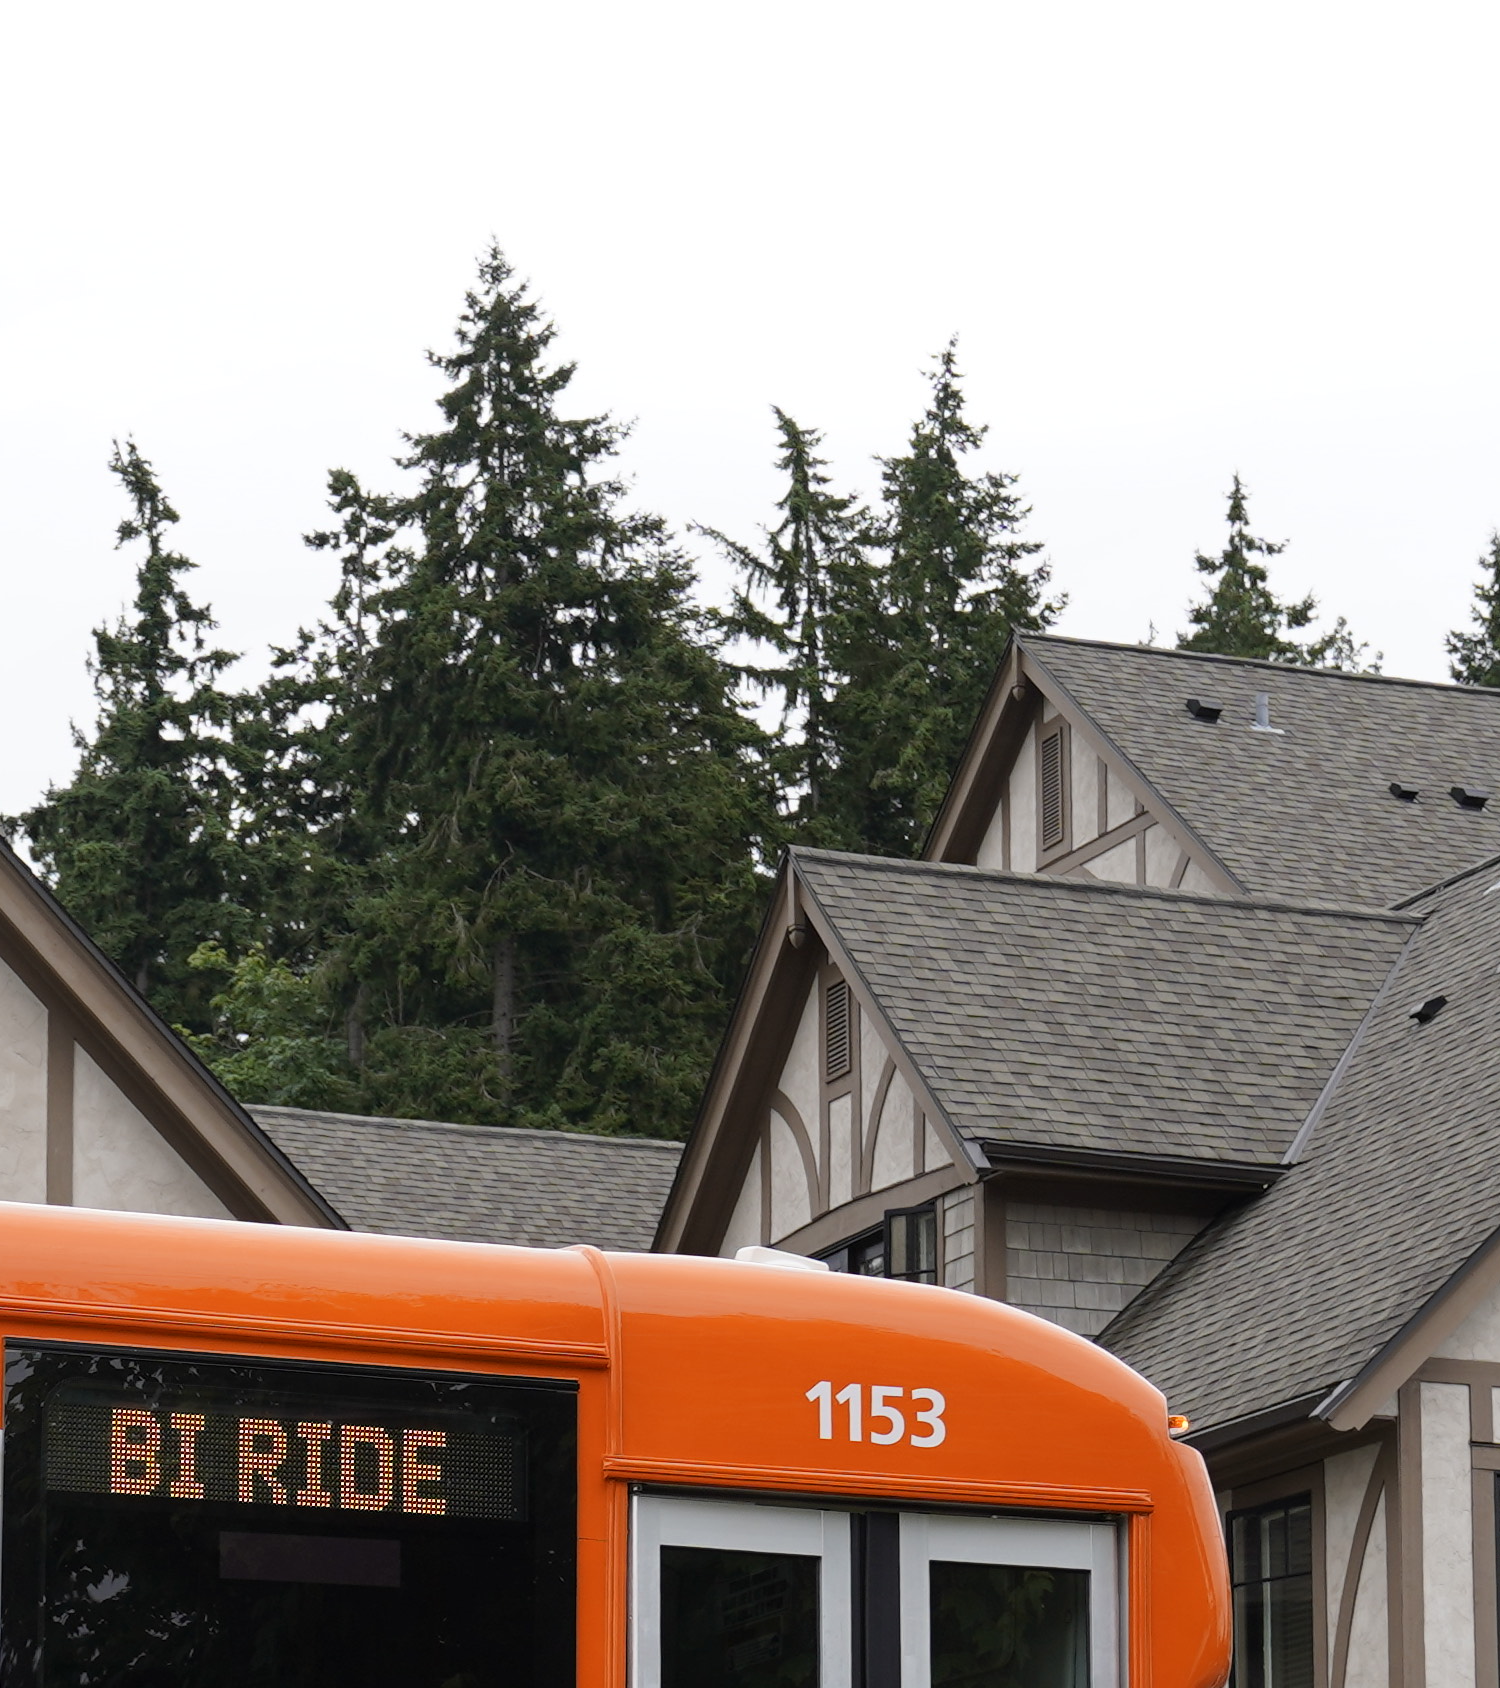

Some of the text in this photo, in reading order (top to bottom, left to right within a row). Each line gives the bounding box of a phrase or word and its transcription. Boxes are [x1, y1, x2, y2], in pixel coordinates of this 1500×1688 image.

[805, 1381, 946, 1448] 1153
[109, 1407, 449, 1516] BI RIDE
